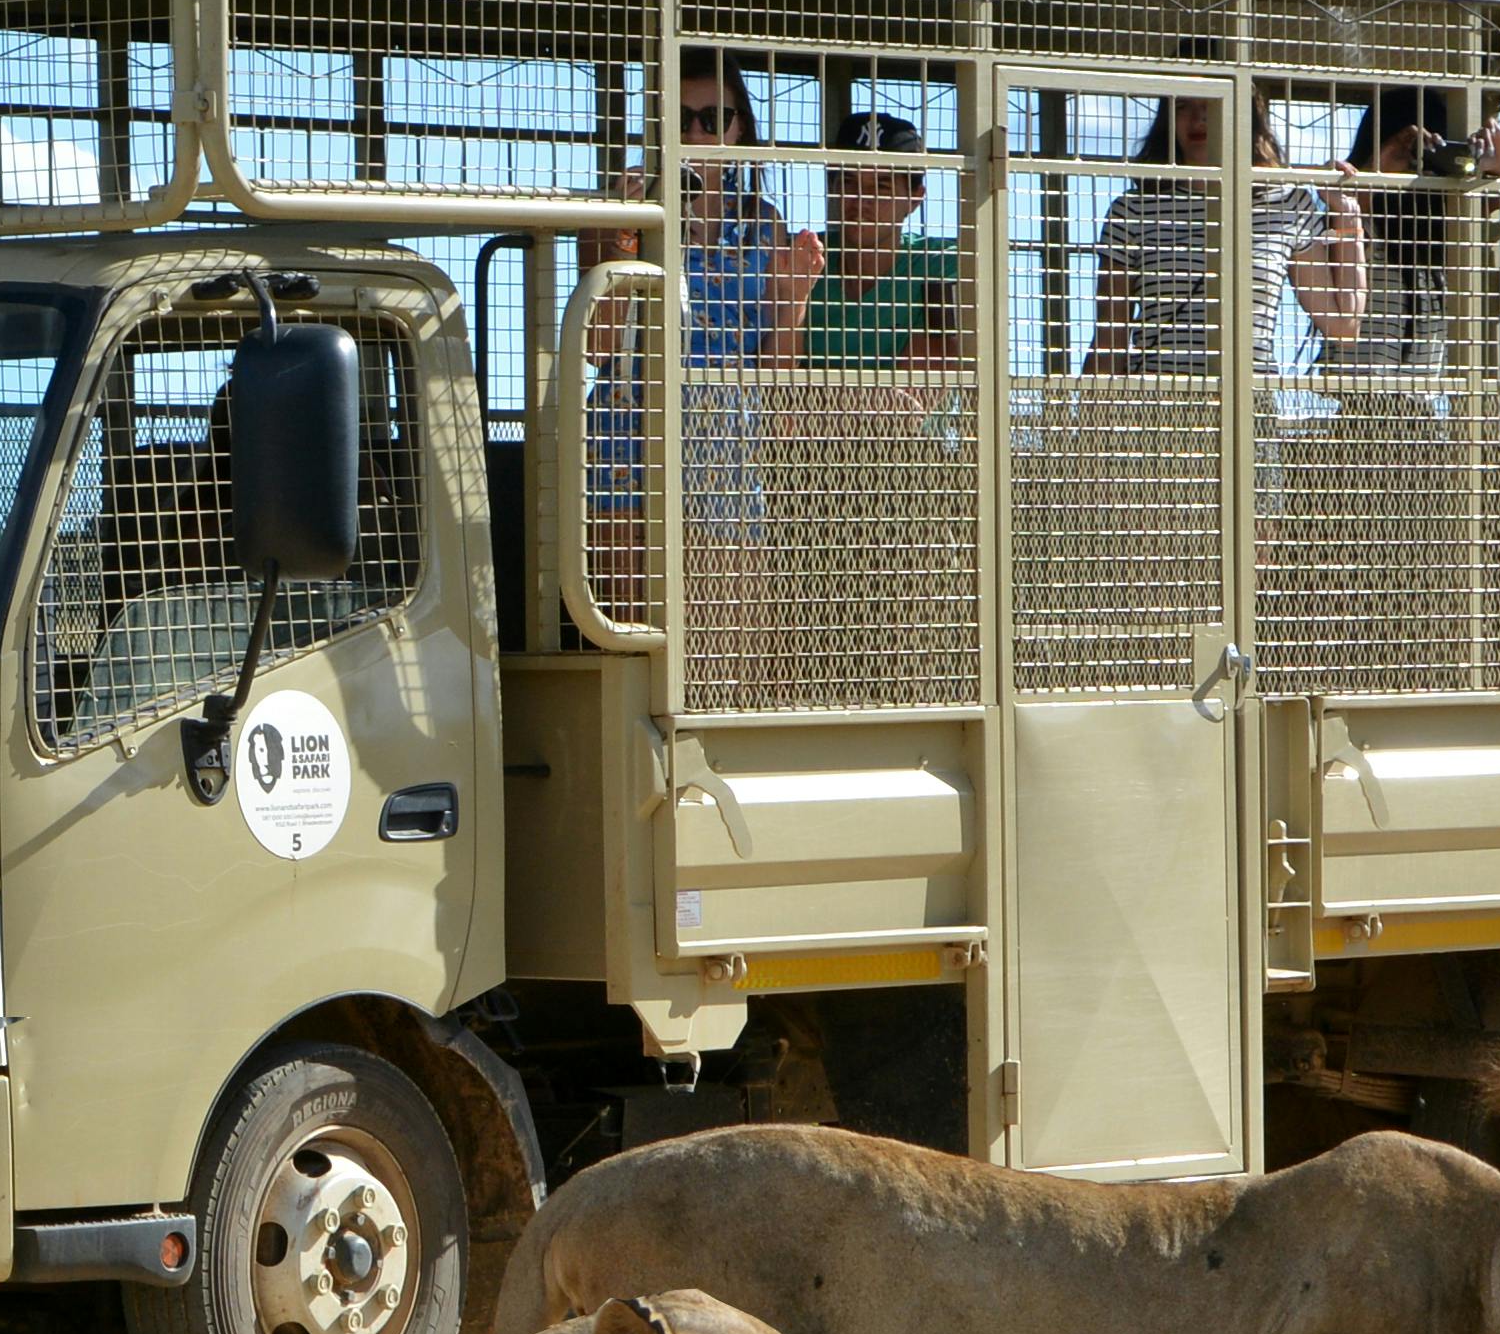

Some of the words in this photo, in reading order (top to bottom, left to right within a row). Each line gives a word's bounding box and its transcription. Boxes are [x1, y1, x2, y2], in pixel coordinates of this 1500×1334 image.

[856, 121, 884, 147] NY
[291, 735, 330, 753] LION
[292, 756, 298, 764] &
[298, 753, 330, 763] SAFARI
[292, 763, 330, 779] PARK
[292, 833, 302, 851] 5
[292, 1091, 366, 1127] REGIONA
